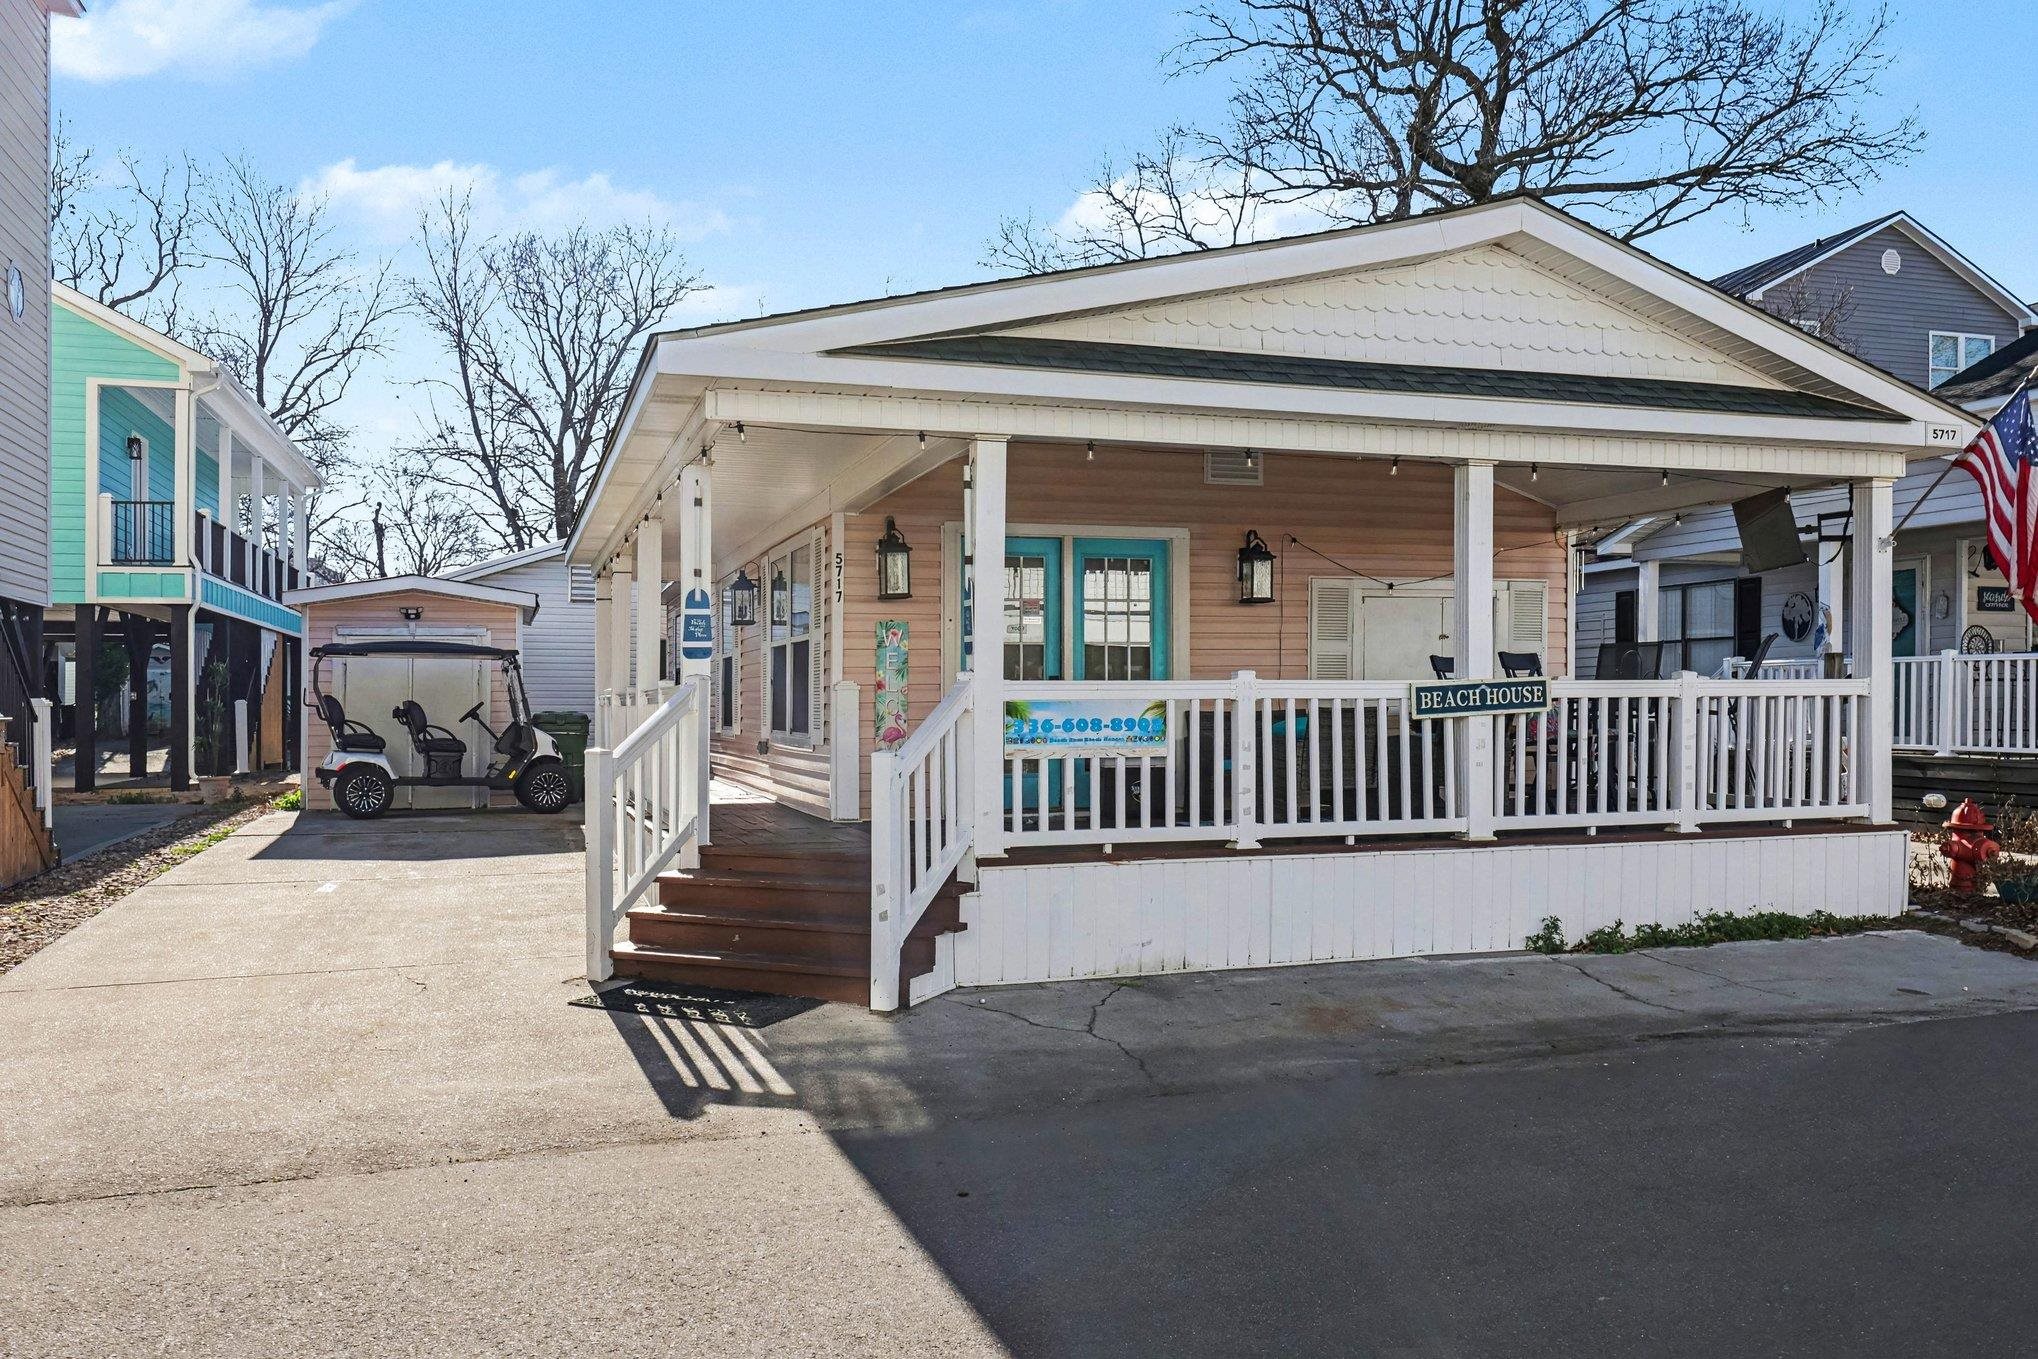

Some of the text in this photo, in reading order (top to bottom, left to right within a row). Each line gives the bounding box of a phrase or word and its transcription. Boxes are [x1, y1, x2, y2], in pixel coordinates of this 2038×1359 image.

[1932, 428, 1957, 441] 5717
[835, 552, 843, 603] 5717
[1419, 685, 1544, 709] BEACH HOUSE
